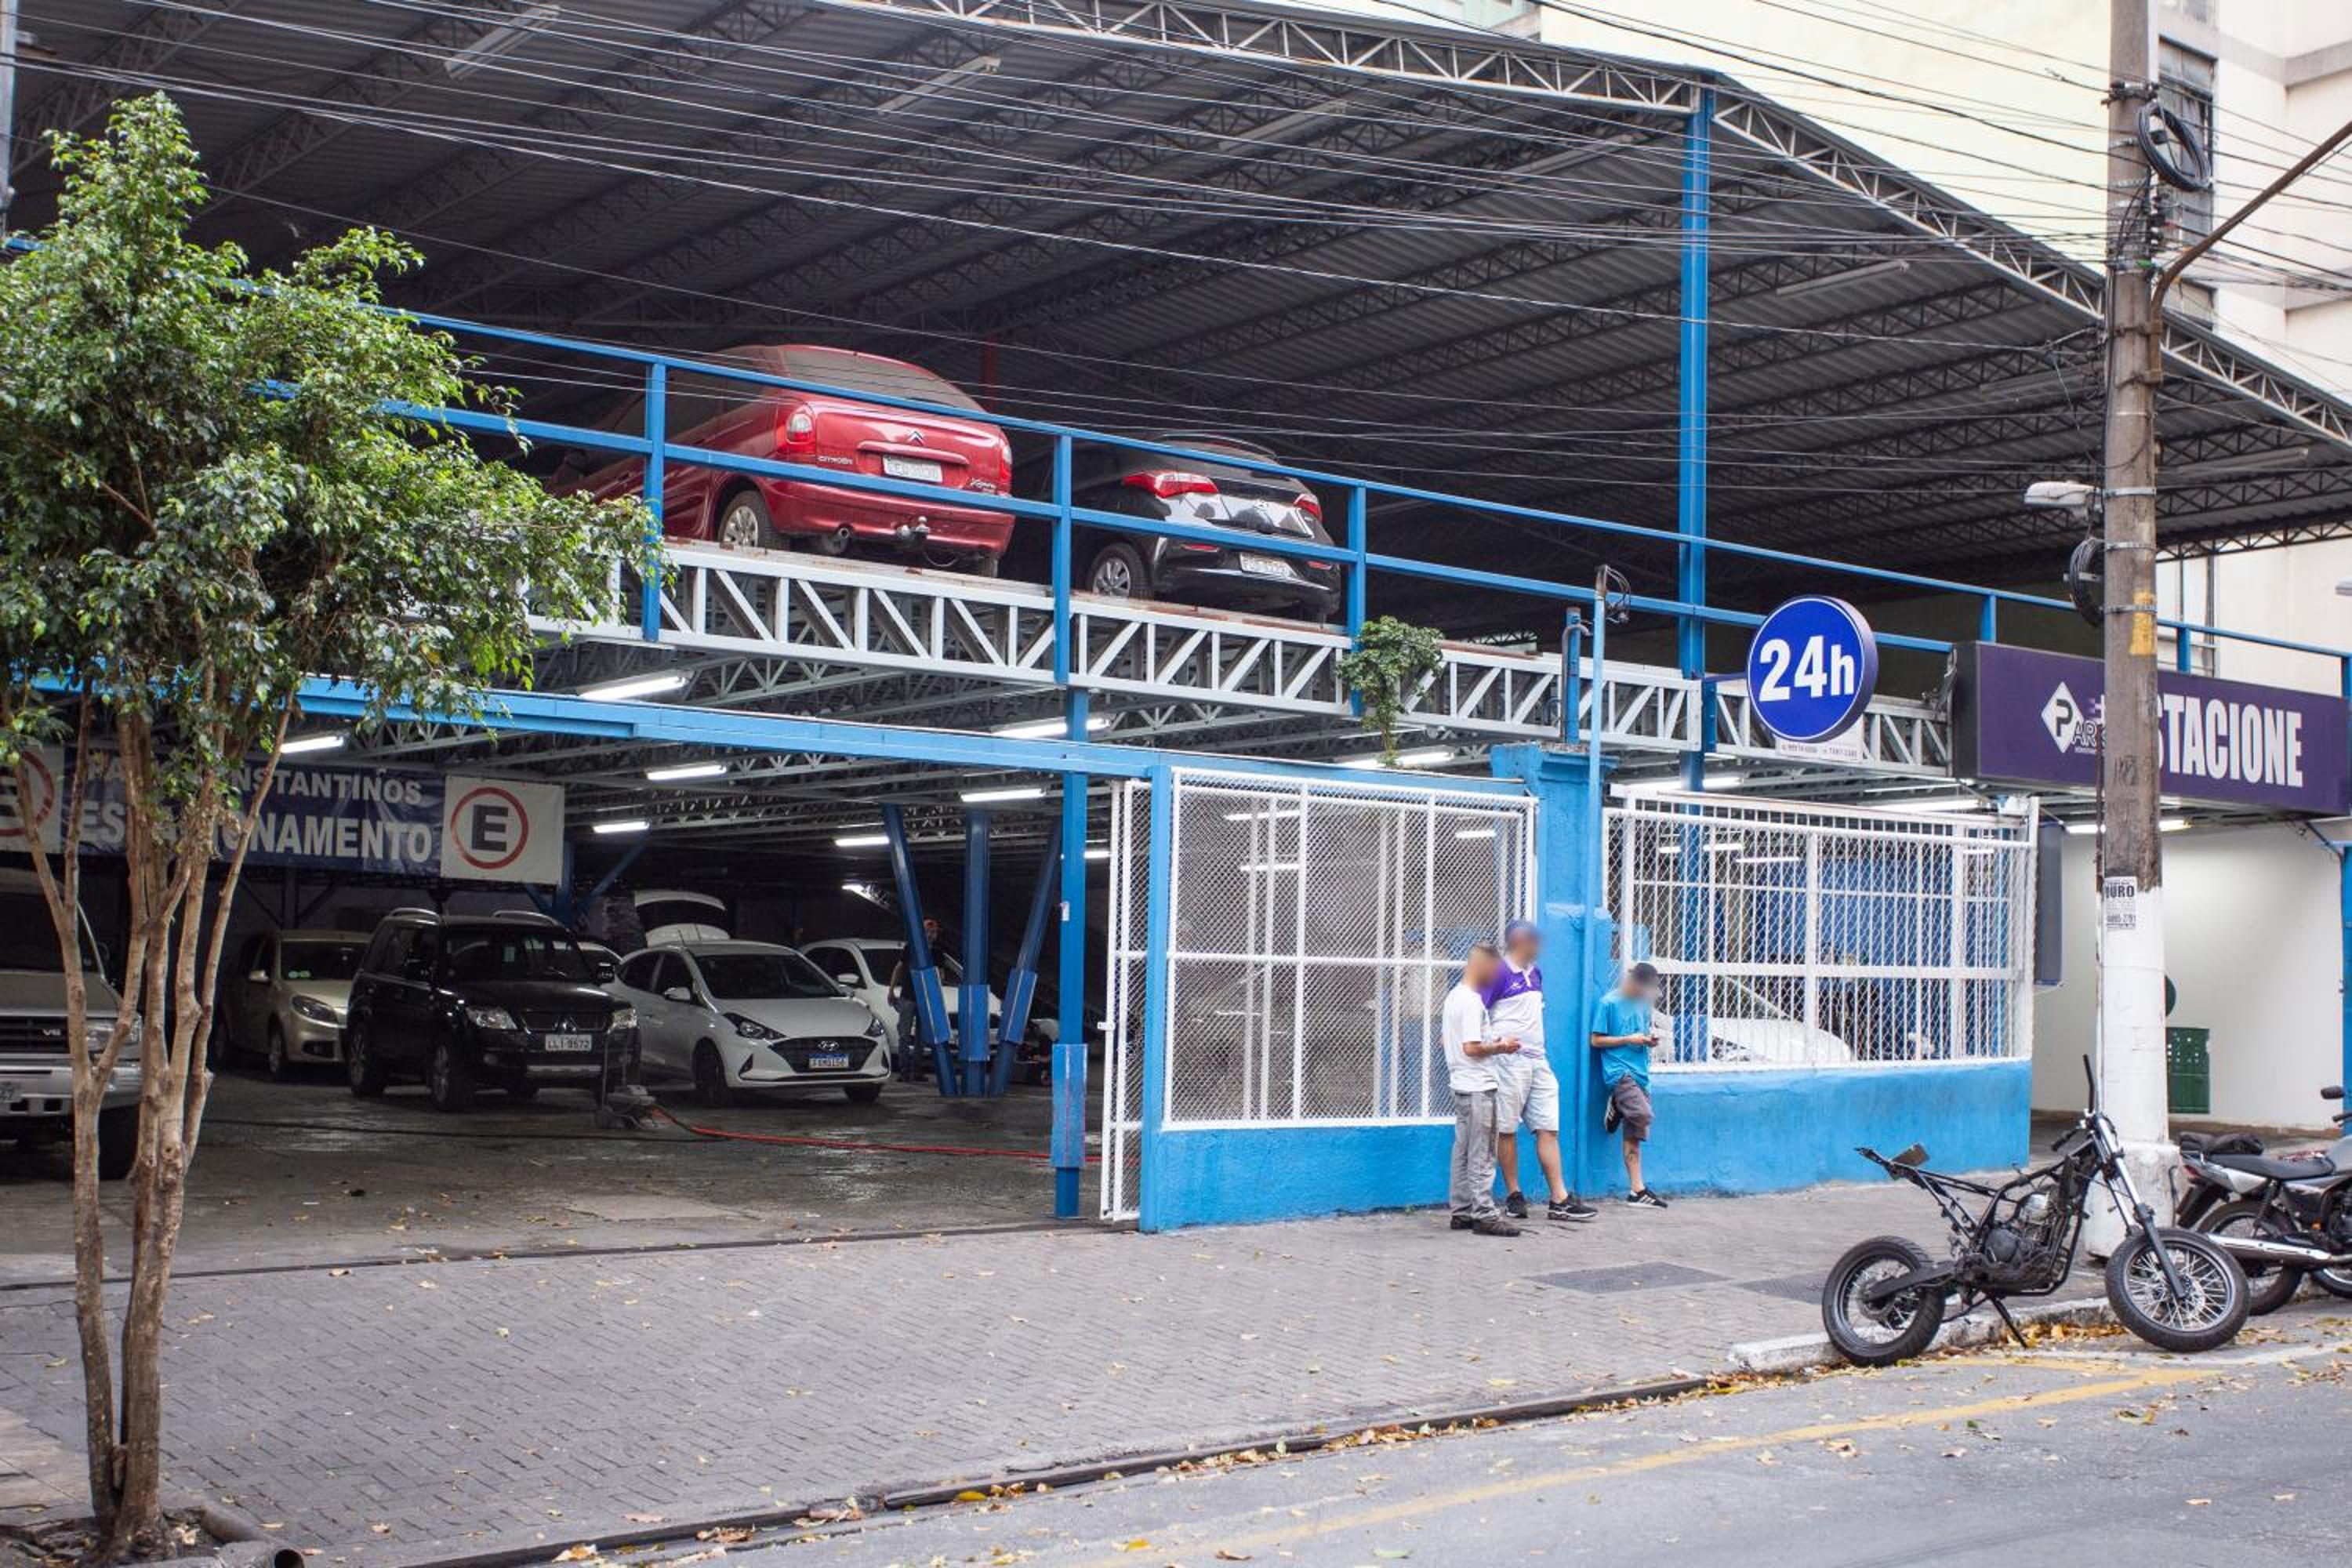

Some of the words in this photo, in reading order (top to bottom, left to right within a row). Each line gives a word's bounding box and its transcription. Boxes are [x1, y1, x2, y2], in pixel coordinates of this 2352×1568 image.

[1759, 635, 1855, 702] 24h
[2157, 693, 2303, 787] TACIONE
[202, 762, 422, 805] NSTANTINOS
[472, 804, 509, 852] E
